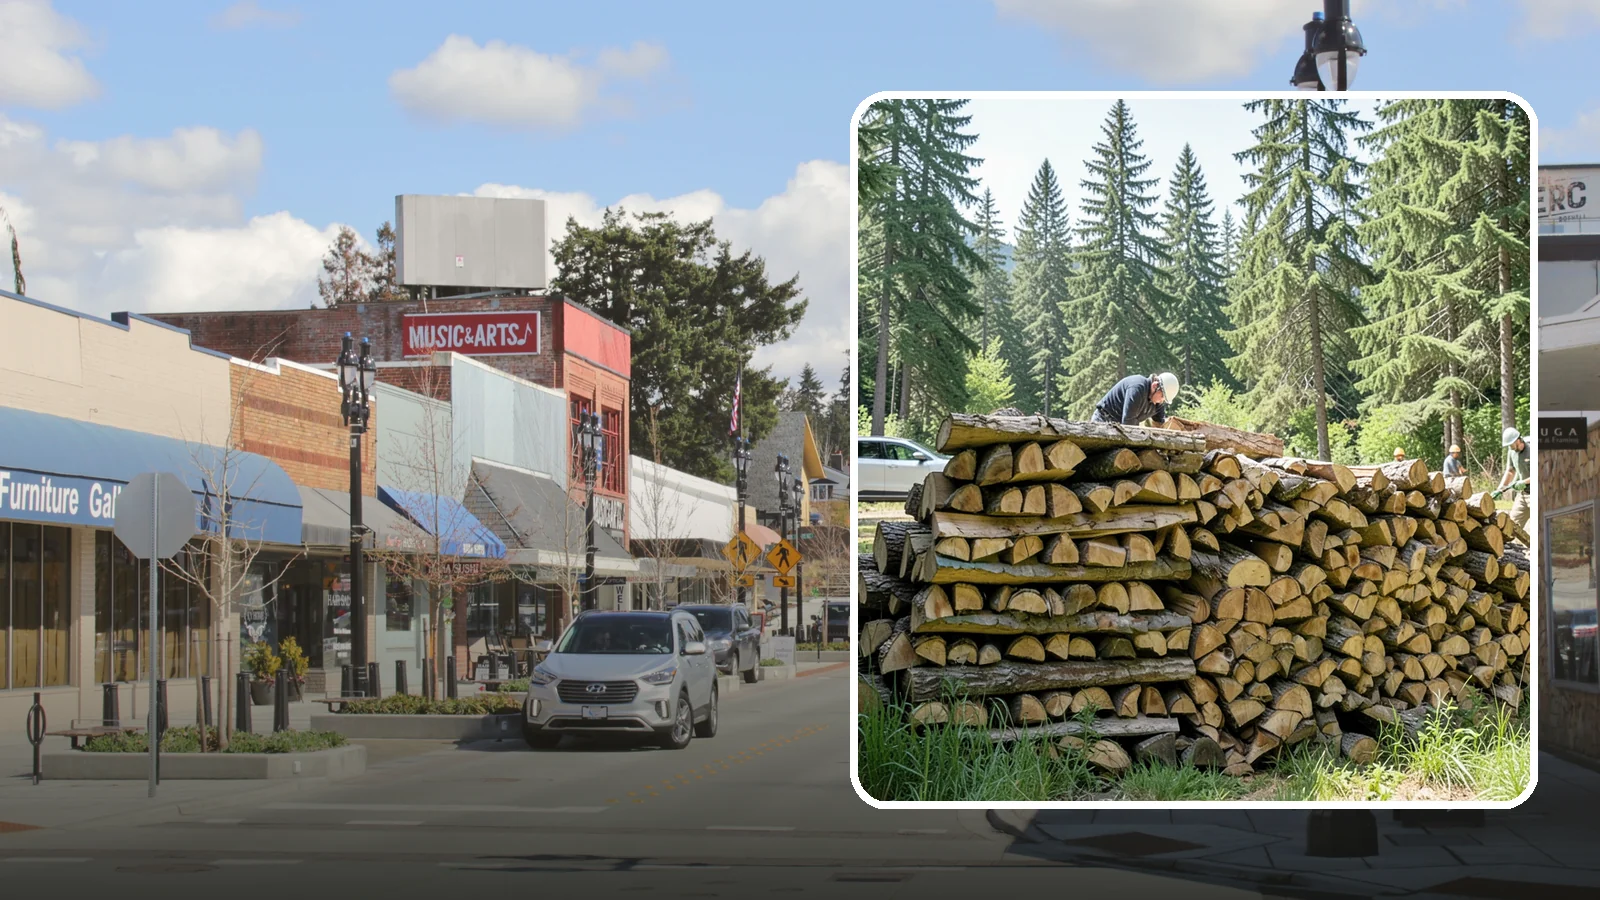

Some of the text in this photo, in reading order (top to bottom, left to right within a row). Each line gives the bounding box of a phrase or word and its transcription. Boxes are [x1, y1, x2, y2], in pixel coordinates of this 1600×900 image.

[409, 323, 519, 348] MUSIC&ARTS
[1540, 427, 1578, 437] UGA
[0, 471, 122, 519] Furniture Gal
